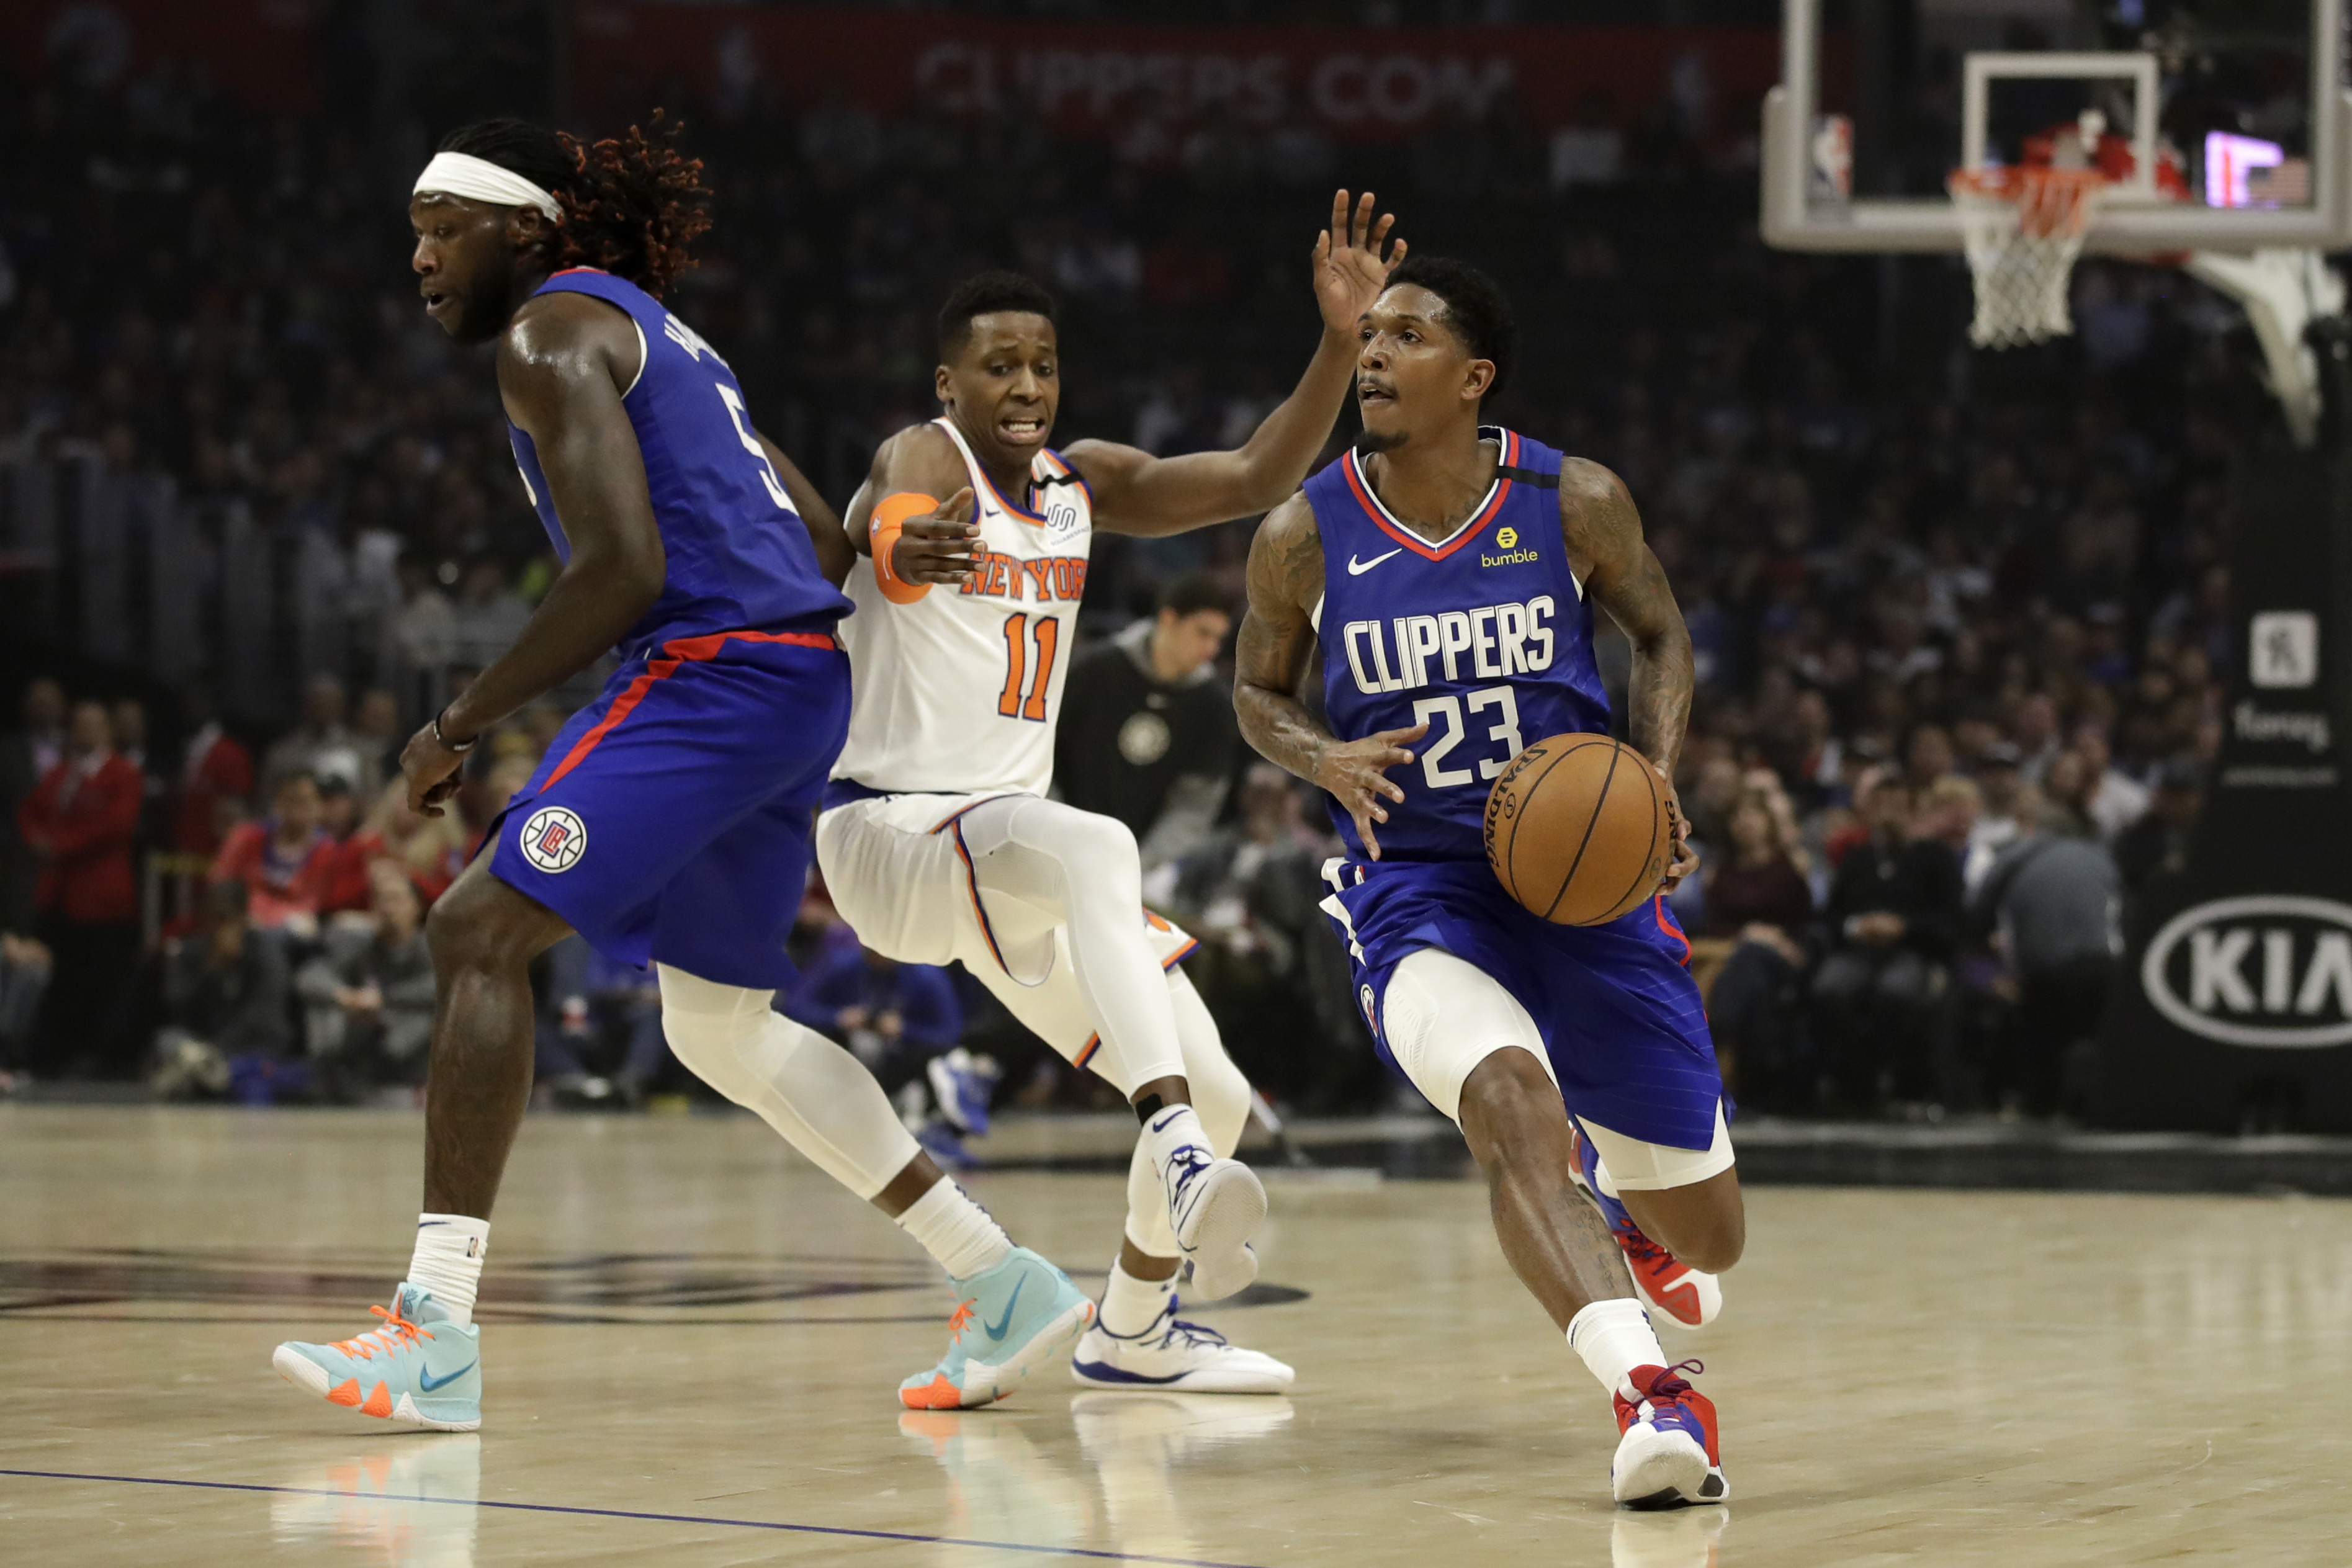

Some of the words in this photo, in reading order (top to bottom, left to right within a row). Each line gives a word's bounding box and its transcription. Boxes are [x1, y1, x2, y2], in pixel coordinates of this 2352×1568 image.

[715, 382, 801, 517] 5
[1024, 556, 1088, 602] YOR
[1481, 548, 1538, 568] bumble
[998, 612, 1059, 723] 11
[1344, 595, 1555, 695] CLIPPERS
[1412, 684, 1524, 789] 23
[1484, 745, 1549, 868] SPALDING
[2190, 929, 2352, 1015] KIA
